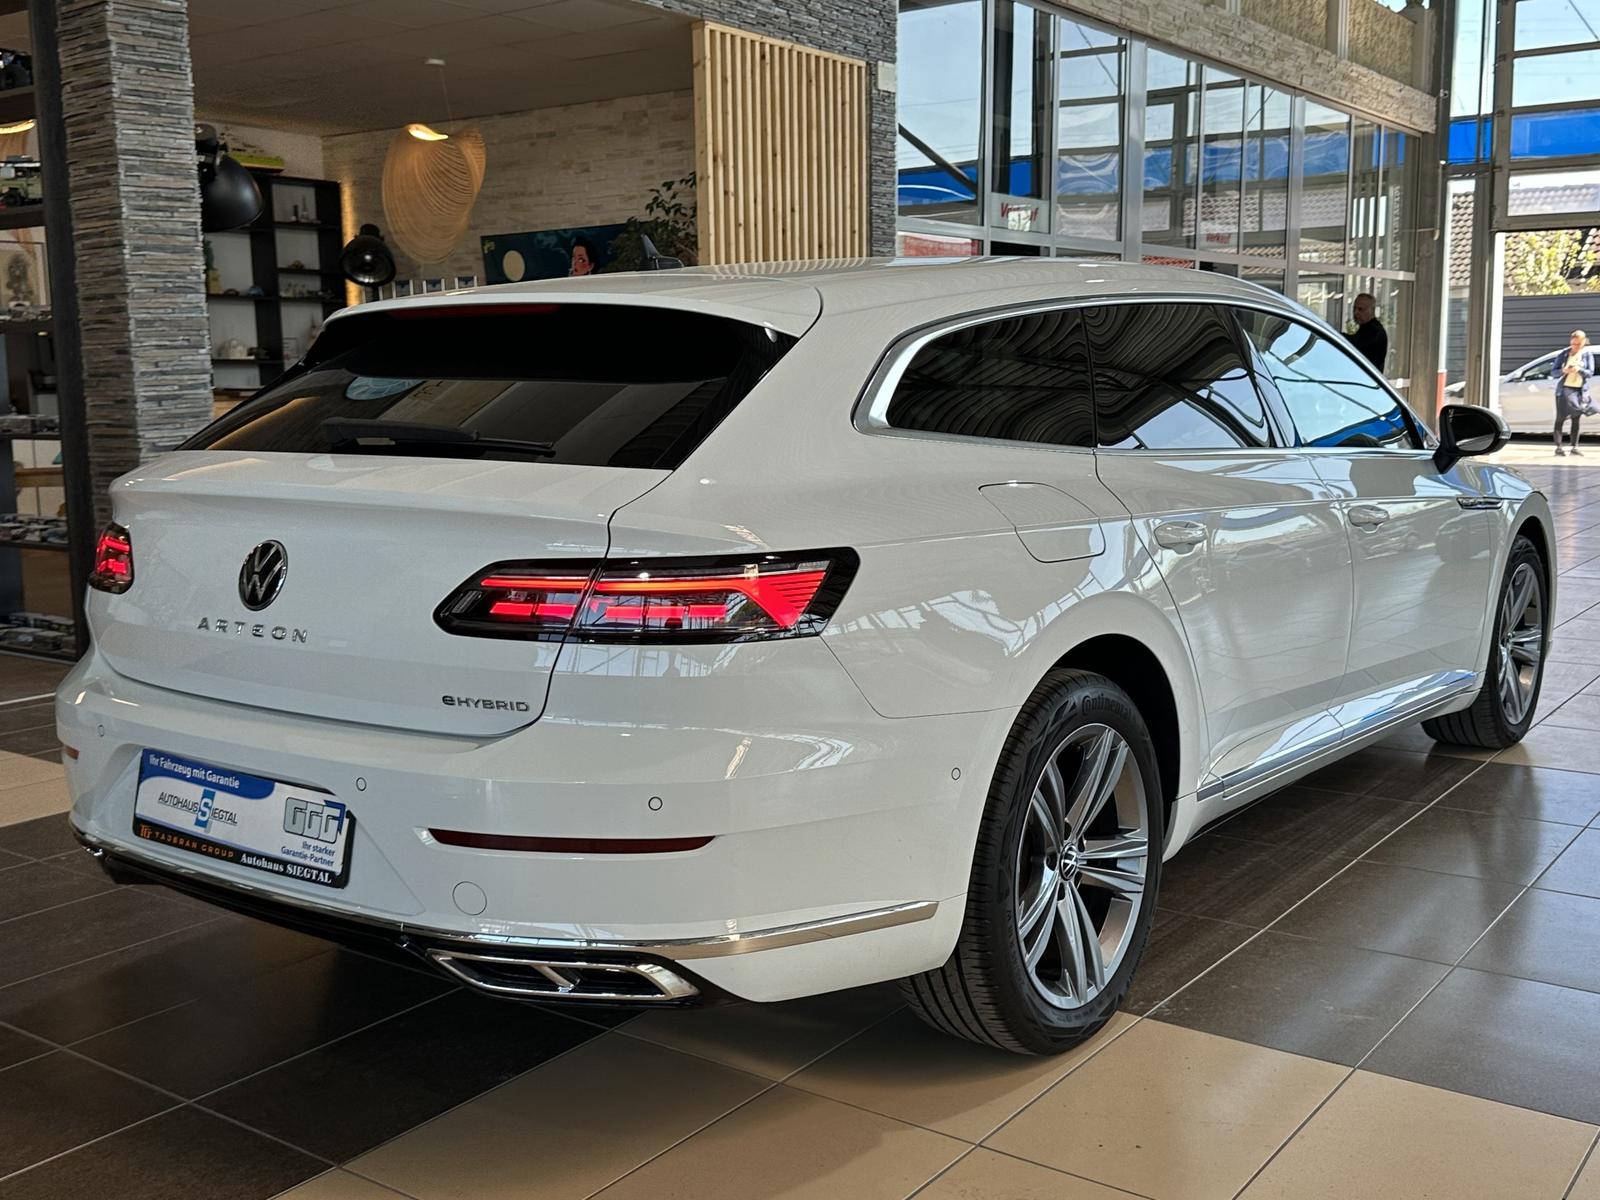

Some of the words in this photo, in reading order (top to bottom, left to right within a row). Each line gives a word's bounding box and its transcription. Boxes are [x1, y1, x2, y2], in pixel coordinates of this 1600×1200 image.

[197, 617, 308, 643] ARTEON
[442, 695, 530, 712] eHYBRID
[149, 754, 159, 766] Ihr
[160, 757, 192, 778] Fahrzeug
[192, 768, 206, 779] mit
[206, 770, 240, 789] Garantie
[158, 791, 199, 813] AUTOHAUS
[198, 798, 238, 824] SIEGTAL
[201, 845, 234, 858] GROUP
[281, 846, 334, 867] Garantie-Partner
[312, 844, 335, 857] starker
[240, 853, 284, 872] Autohaus
[286, 863, 332, 884] SIEGTAL
